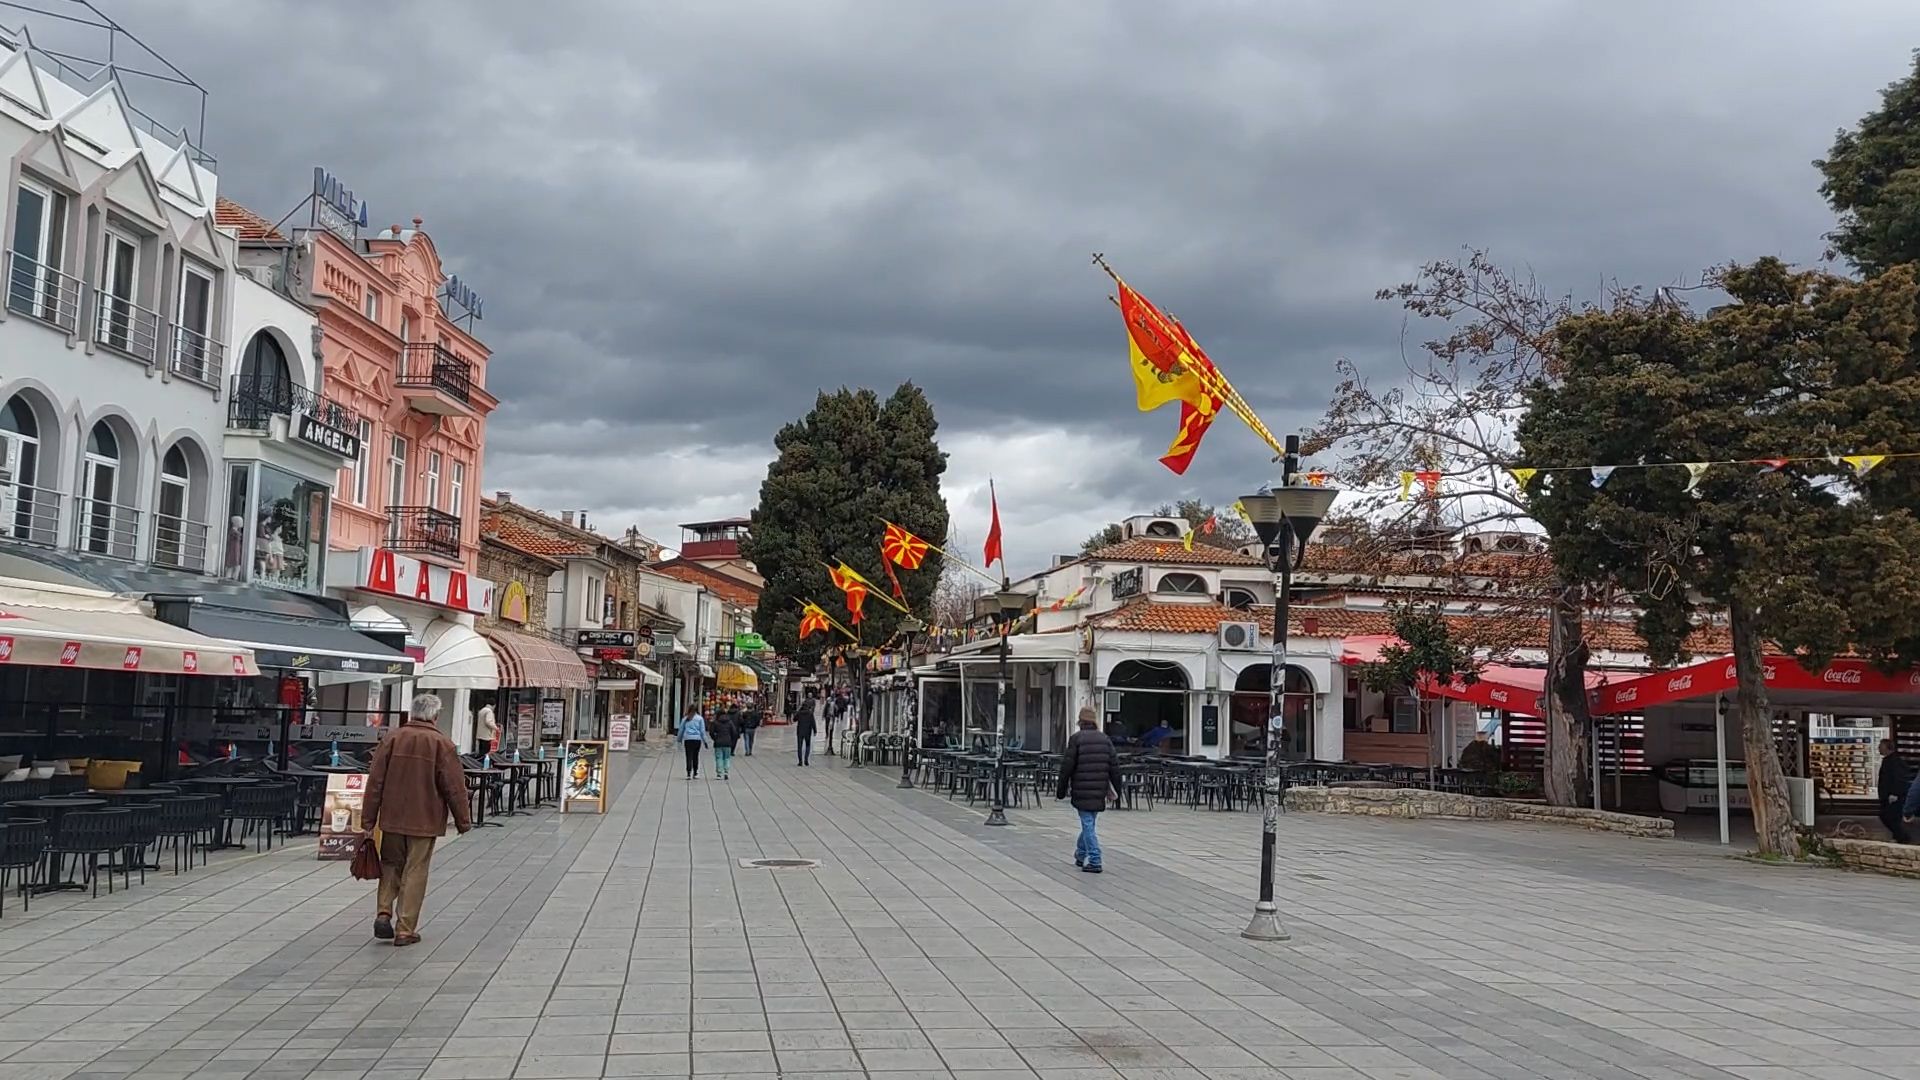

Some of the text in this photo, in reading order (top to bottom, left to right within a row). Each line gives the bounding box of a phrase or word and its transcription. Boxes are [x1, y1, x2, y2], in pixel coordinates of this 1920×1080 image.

[314, 167, 368, 228] VILLA
[305, 421, 354, 456] ANGELA
[589, 632, 622, 640] DISTRICT
[62, 645, 78, 663] illy
[125, 650, 139, 667] illy
[183, 654, 196, 671] illy
[346, 776, 361, 788] illy
